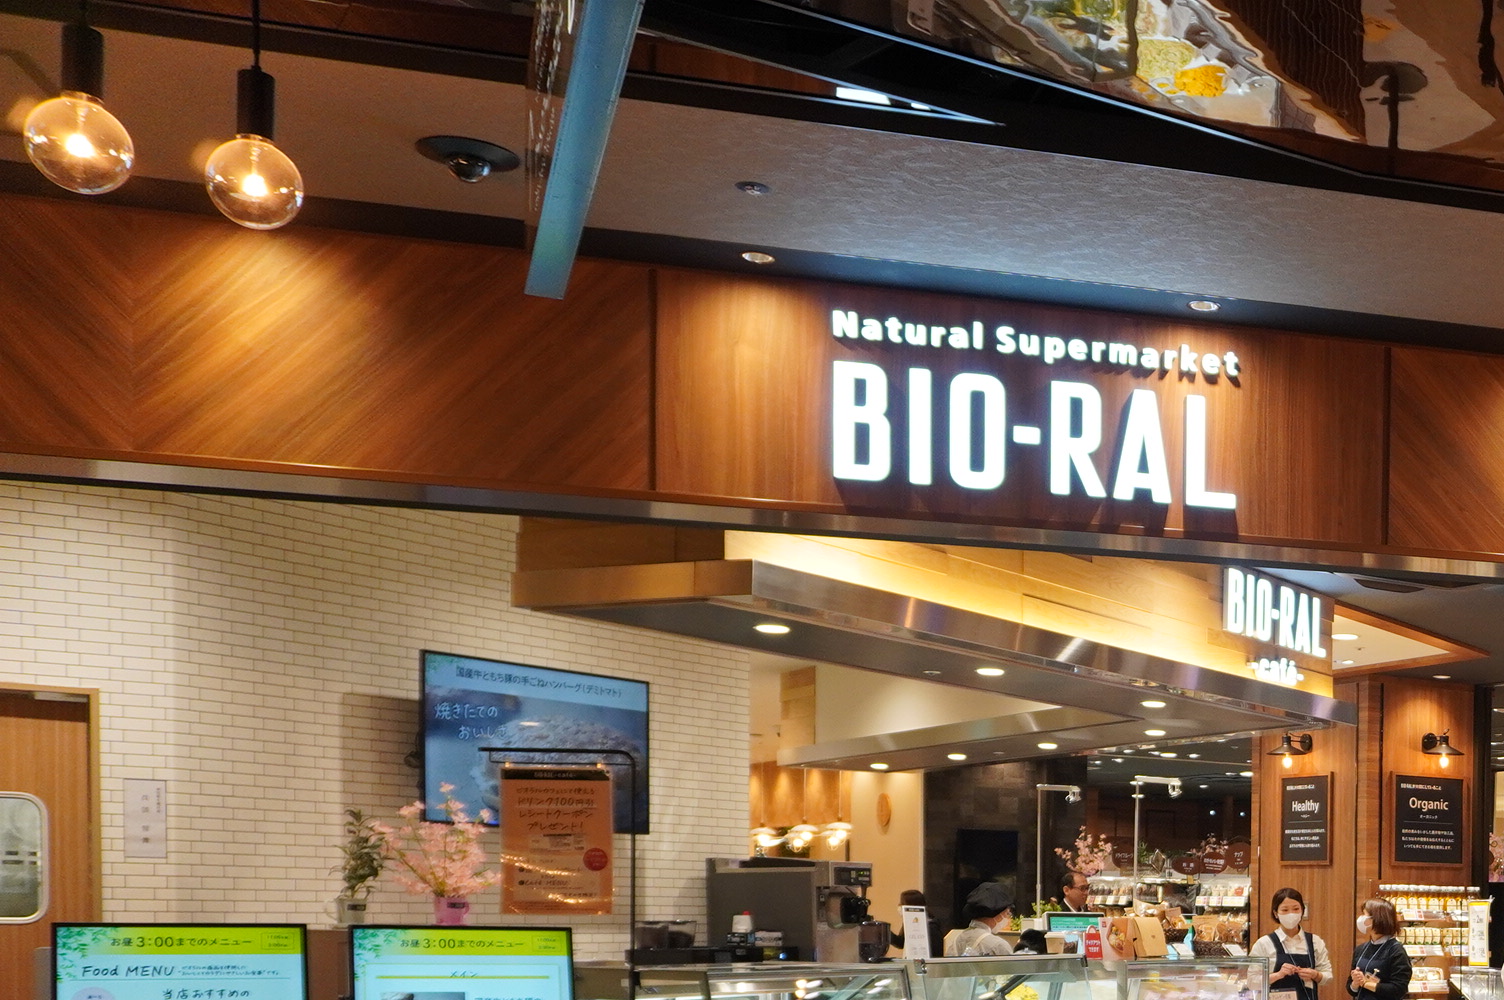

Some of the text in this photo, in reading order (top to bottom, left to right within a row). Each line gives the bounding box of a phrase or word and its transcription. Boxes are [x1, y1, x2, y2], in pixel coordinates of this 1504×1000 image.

[831, 309, 1239, 378] Natural Supermarket
[832, 359, 1237, 510] BIO-RAL
[1227, 566, 1327, 658] BIO-RAL
[434, 703, 499, 720] 焼きたての
[1291, 799, 1320, 814] Healthy
[1408, 796, 1449, 812] Organic
[81, 965, 175, 978] Food MENU
[162, 988, 250, 1000] 当店おすすめの
